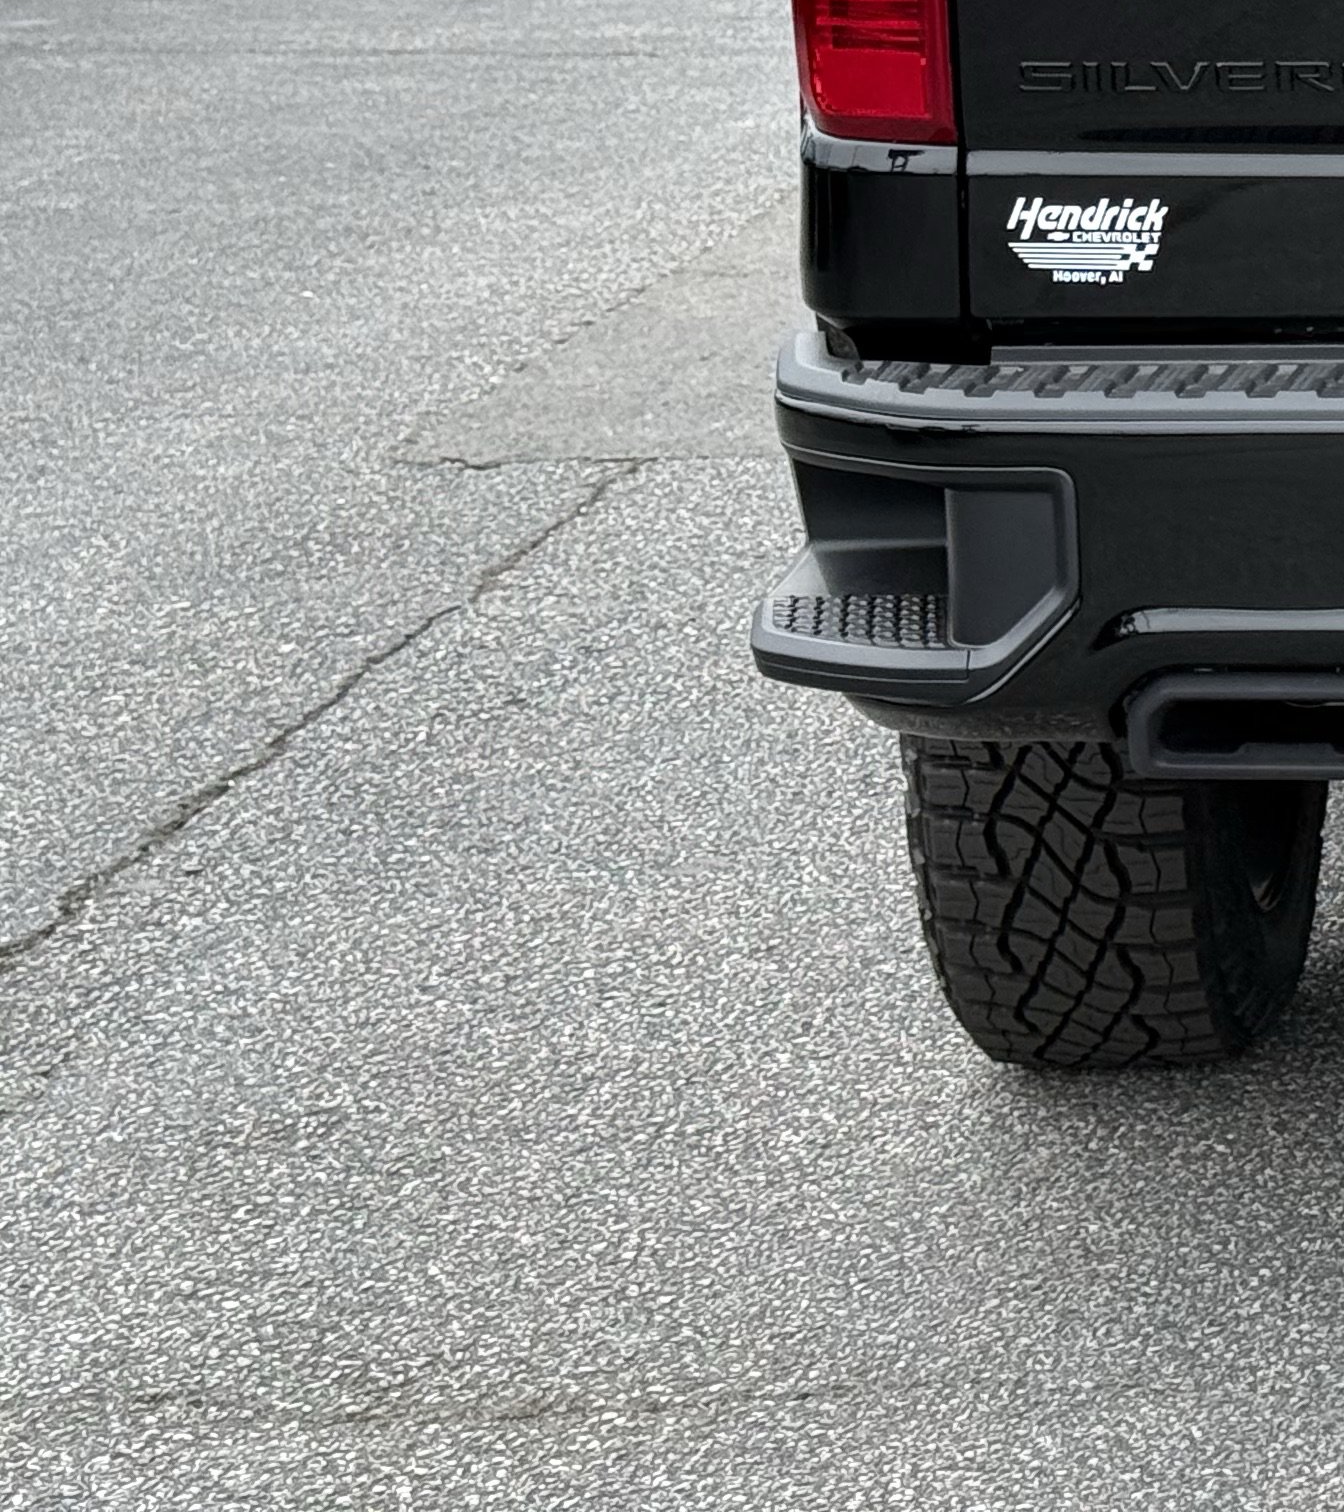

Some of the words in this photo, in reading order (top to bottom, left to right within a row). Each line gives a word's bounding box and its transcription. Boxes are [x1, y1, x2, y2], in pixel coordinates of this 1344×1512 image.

[1006, 197, 1169, 240] Hendrick
[1072, 231, 1162, 243] CHEVROLET
[1052, 270, 1107, 286] Hoover,
